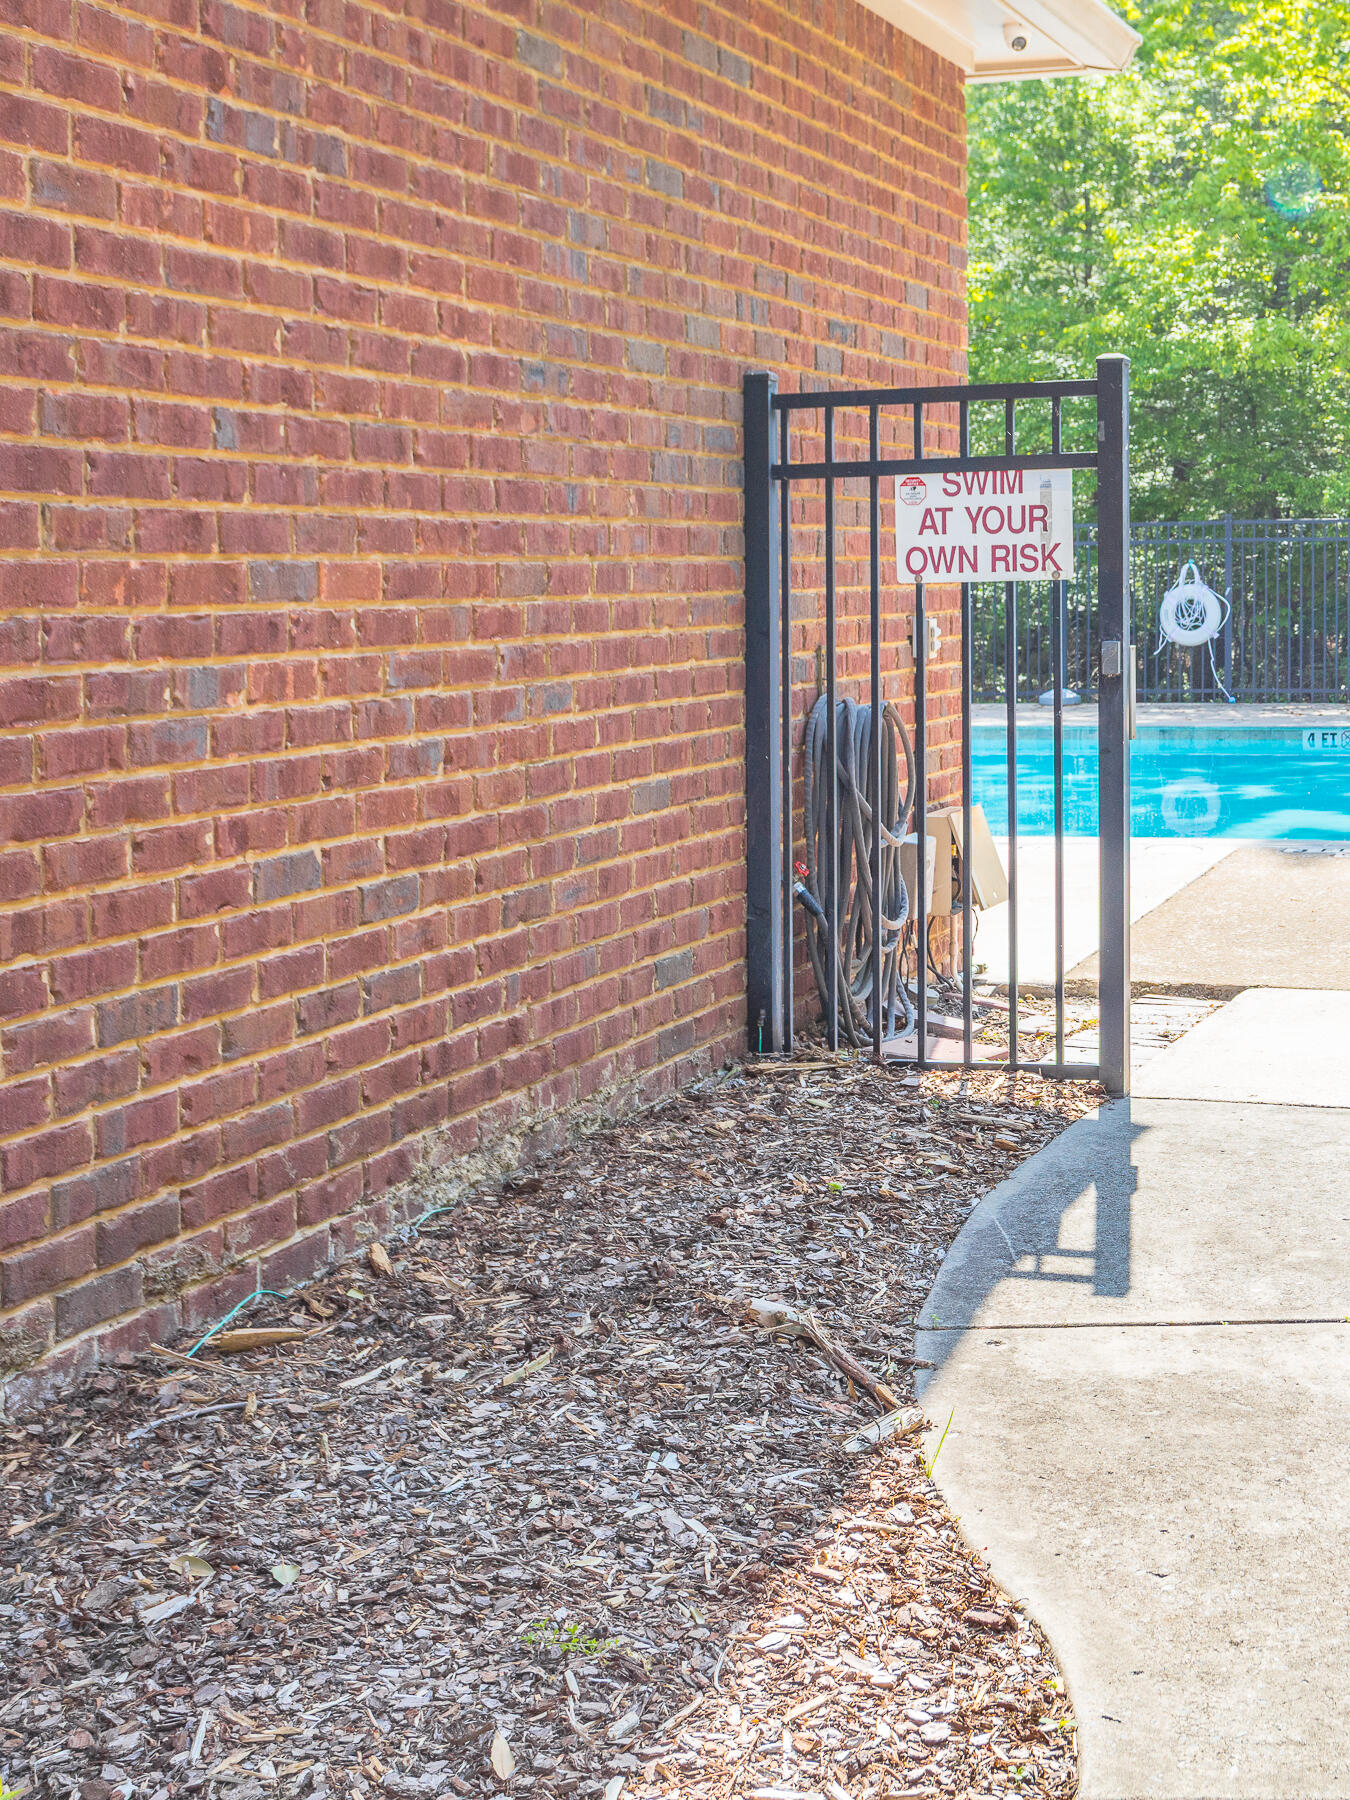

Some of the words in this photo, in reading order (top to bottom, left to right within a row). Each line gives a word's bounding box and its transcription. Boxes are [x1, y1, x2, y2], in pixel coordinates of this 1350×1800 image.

[942, 470, 1024, 497] SWIM
[918, 507, 953, 535] AT
[964, 504, 1049, 534] YOUR
[905, 545, 979, 575] OWN
[991, 542, 1063, 573] RISK
